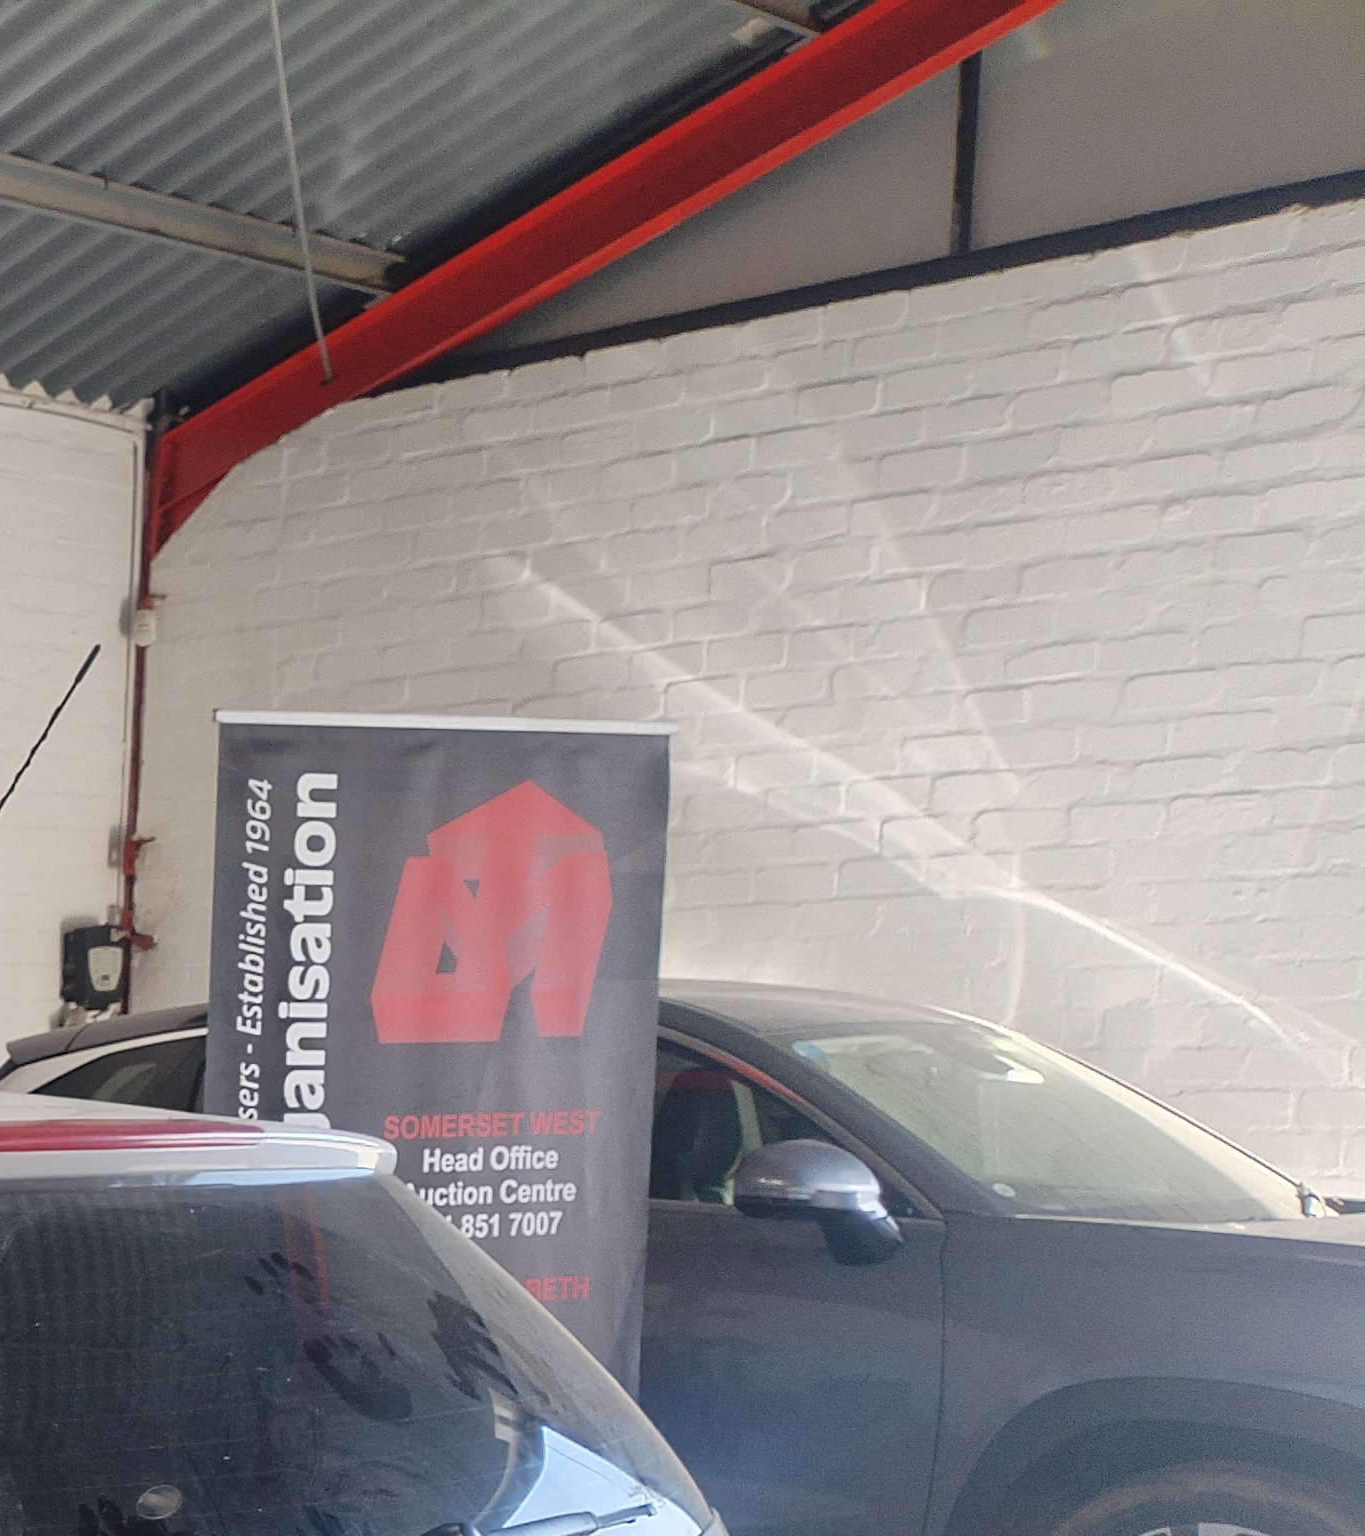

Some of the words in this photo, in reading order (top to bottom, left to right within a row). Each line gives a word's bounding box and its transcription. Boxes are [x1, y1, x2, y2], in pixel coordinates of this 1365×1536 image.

[245, 778, 273, 854] 1964
[236, 862, 268, 1036] Established
[383, 1112, 525, 1140] SOMERSET
[529, 1110, 600, 1137] WEST
[422, 1146, 484, 1173] Head
[490, 1145, 560, 1171] Office
[406, 1181, 493, 1206] uction
[499, 1178, 577, 1204] Centre
[461, 1213, 500, 1238] 851
[508, 1211, 563, 1237] 7007
